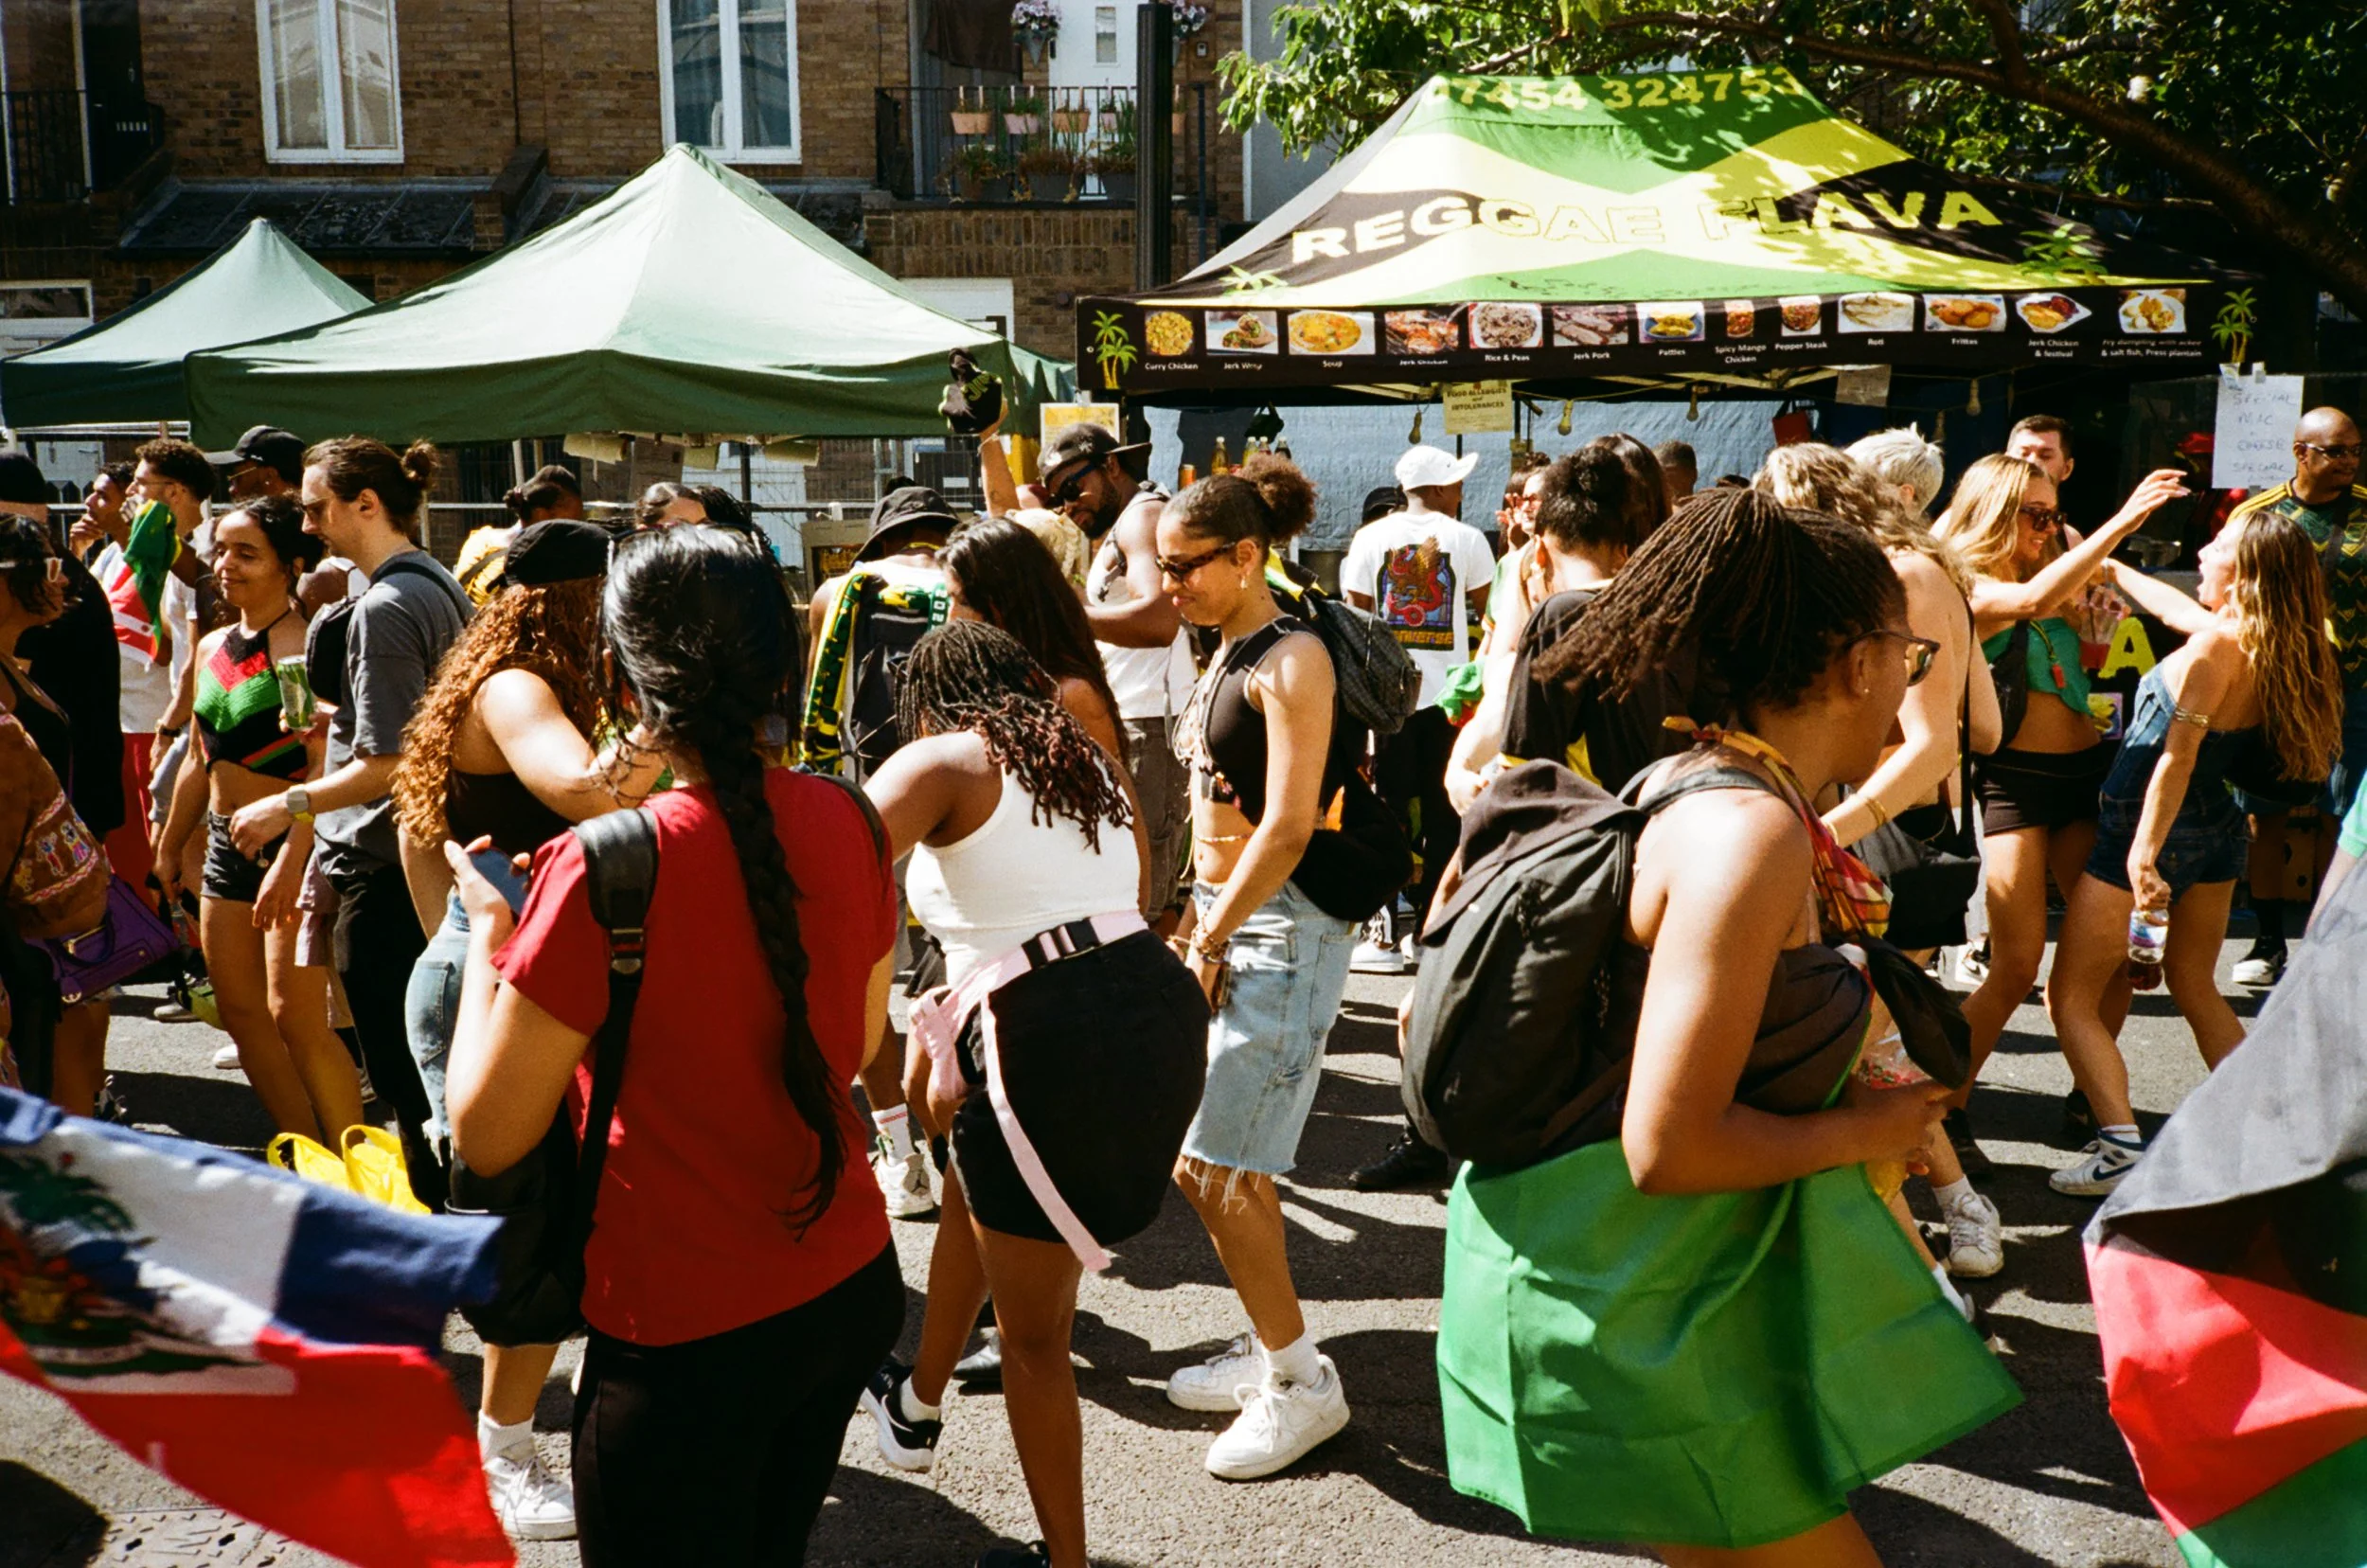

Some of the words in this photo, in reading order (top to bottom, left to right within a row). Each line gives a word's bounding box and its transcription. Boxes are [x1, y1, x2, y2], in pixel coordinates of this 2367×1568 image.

[1290, 195, 1665, 265] REGGAE
[1698, 189, 2003, 241] FLAVA
[1773, 343, 1804, 351] Pepper
[1805, 341, 1828, 349] Steak
[1867, 337, 1885, 347] Roti
[2046, 339, 2080, 347] Chicken
[1714, 346, 1736, 354] Spicy
[1737, 344, 1768, 353] Mango
[2034, 349, 2042, 358] &
[2043, 349, 2073, 358] festival
[2100, 348, 2109, 357] &
[2109, 348, 2126, 357] salt
[2145, 348, 2167, 357] Press
[2167, 349, 2202, 358] plantain
[1484, 353, 1503, 362] Rice
[1503, 353, 1510, 362] &
[1511, 353, 1531, 362] Peas
[1573, 351, 1591, 361] Jerk
[1591, 351, 1611, 360] Pork
[1724, 355, 1757, 365] Chicken
[1144, 362, 1167, 372] Curry
[1166, 362, 1200, 370] Chicken
[1223, 362, 1240, 370] Jerk
[1322, 359, 1344, 368] Soup
[1447, 389, 1468, 398] FOOD
[1451, 401, 1505, 411] INTOLERANCES
